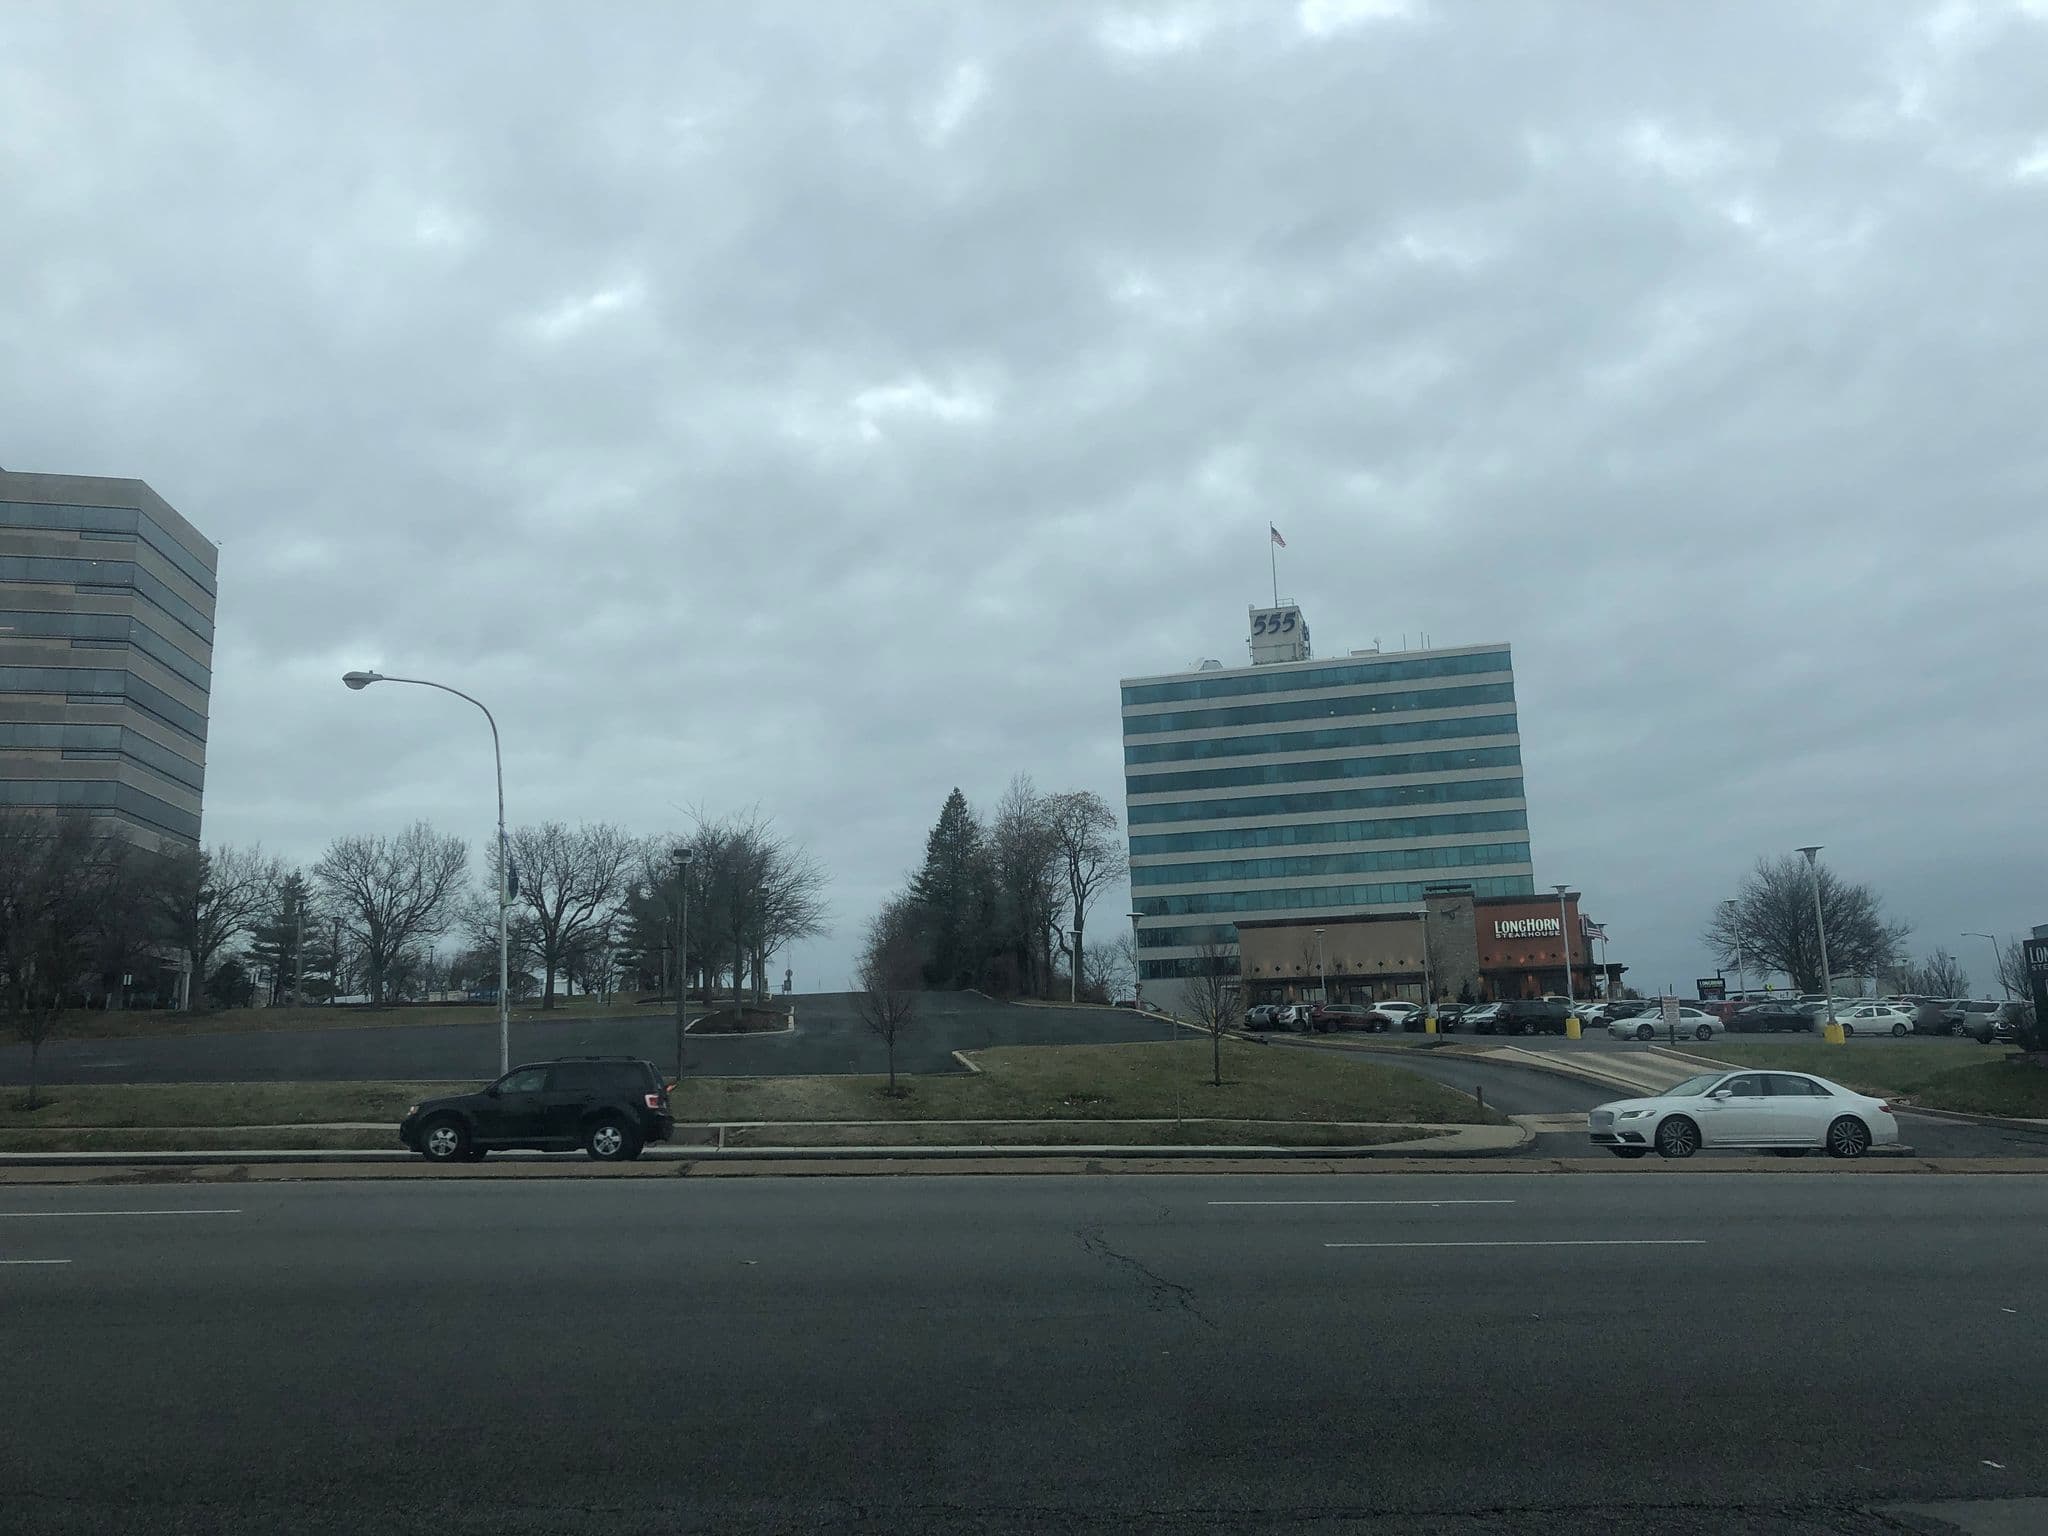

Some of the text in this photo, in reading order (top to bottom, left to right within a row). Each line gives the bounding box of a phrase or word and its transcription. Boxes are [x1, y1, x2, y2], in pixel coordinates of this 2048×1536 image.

[1254, 612, 1295, 636] 555
[1494, 918, 1560, 934] LONGHORN
[1495, 931, 1561, 939] STEAKHOUSE
